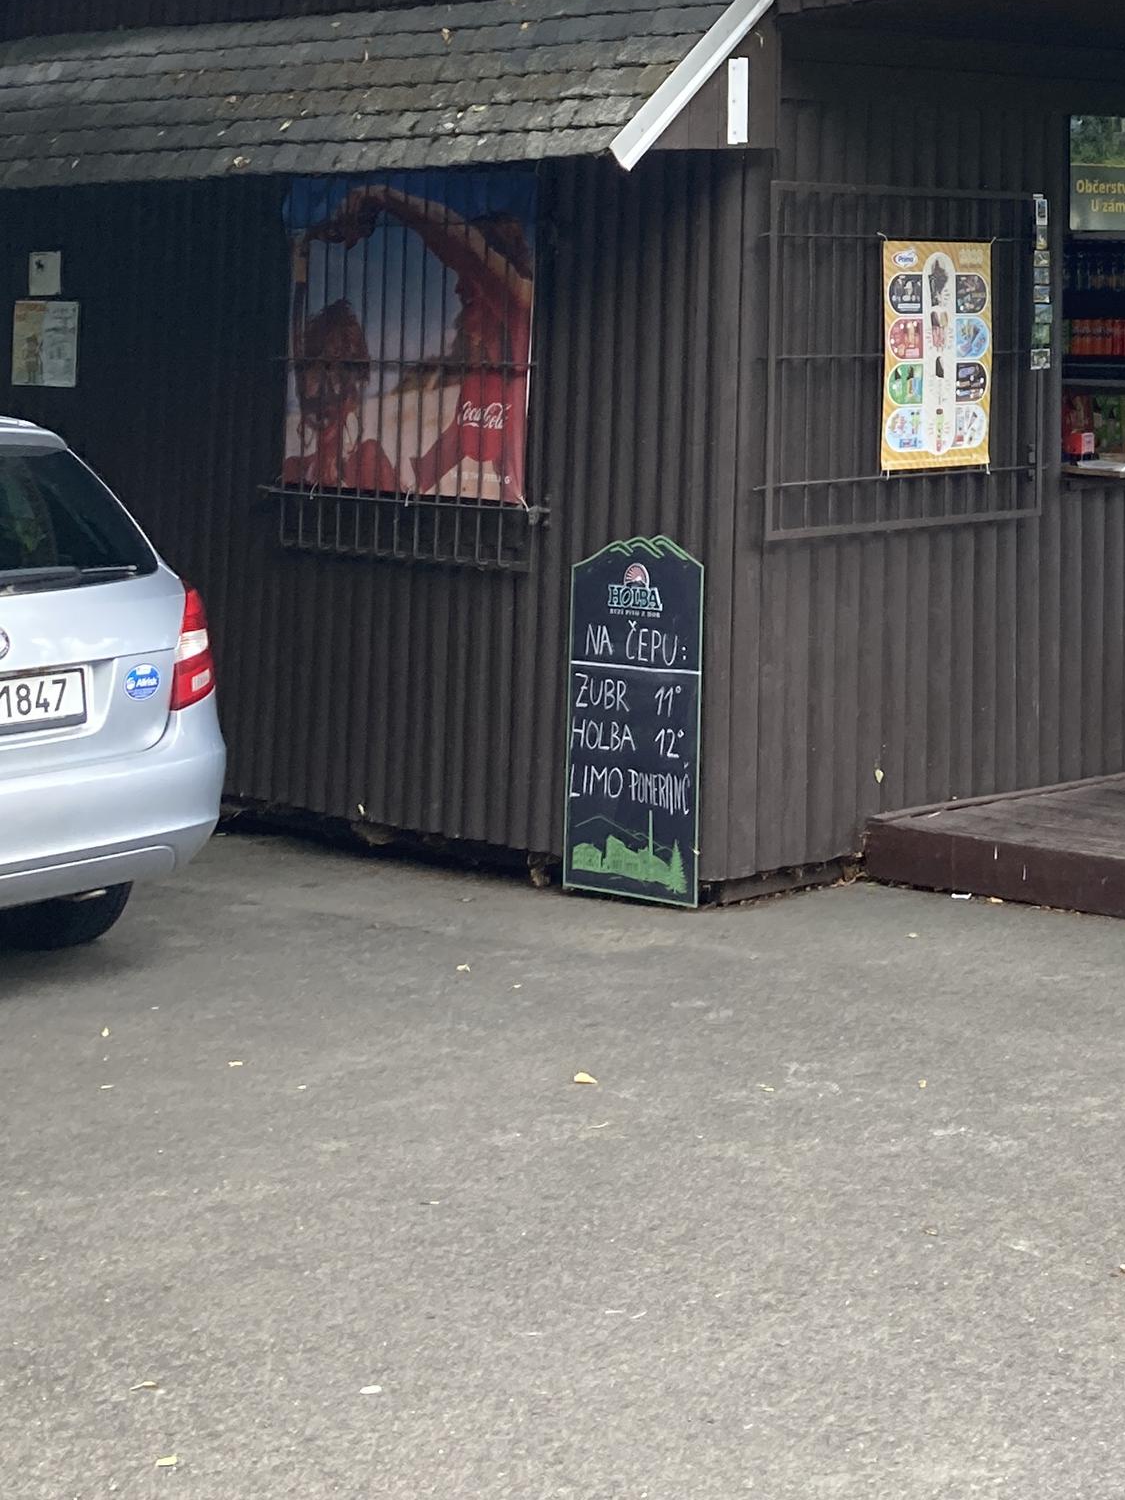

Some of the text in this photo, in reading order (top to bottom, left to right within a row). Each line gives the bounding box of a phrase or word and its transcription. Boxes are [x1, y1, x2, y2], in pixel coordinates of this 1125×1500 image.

[1091, 200, 1099, 212] U
[608, 584, 663, 611] HOLBA
[585, 624, 613, 655] NA
[575, 673, 629, 712] ZUBR
[570, 716, 636, 752] HOLBA
[569, 761, 690, 815] LIMO POMERANČ
